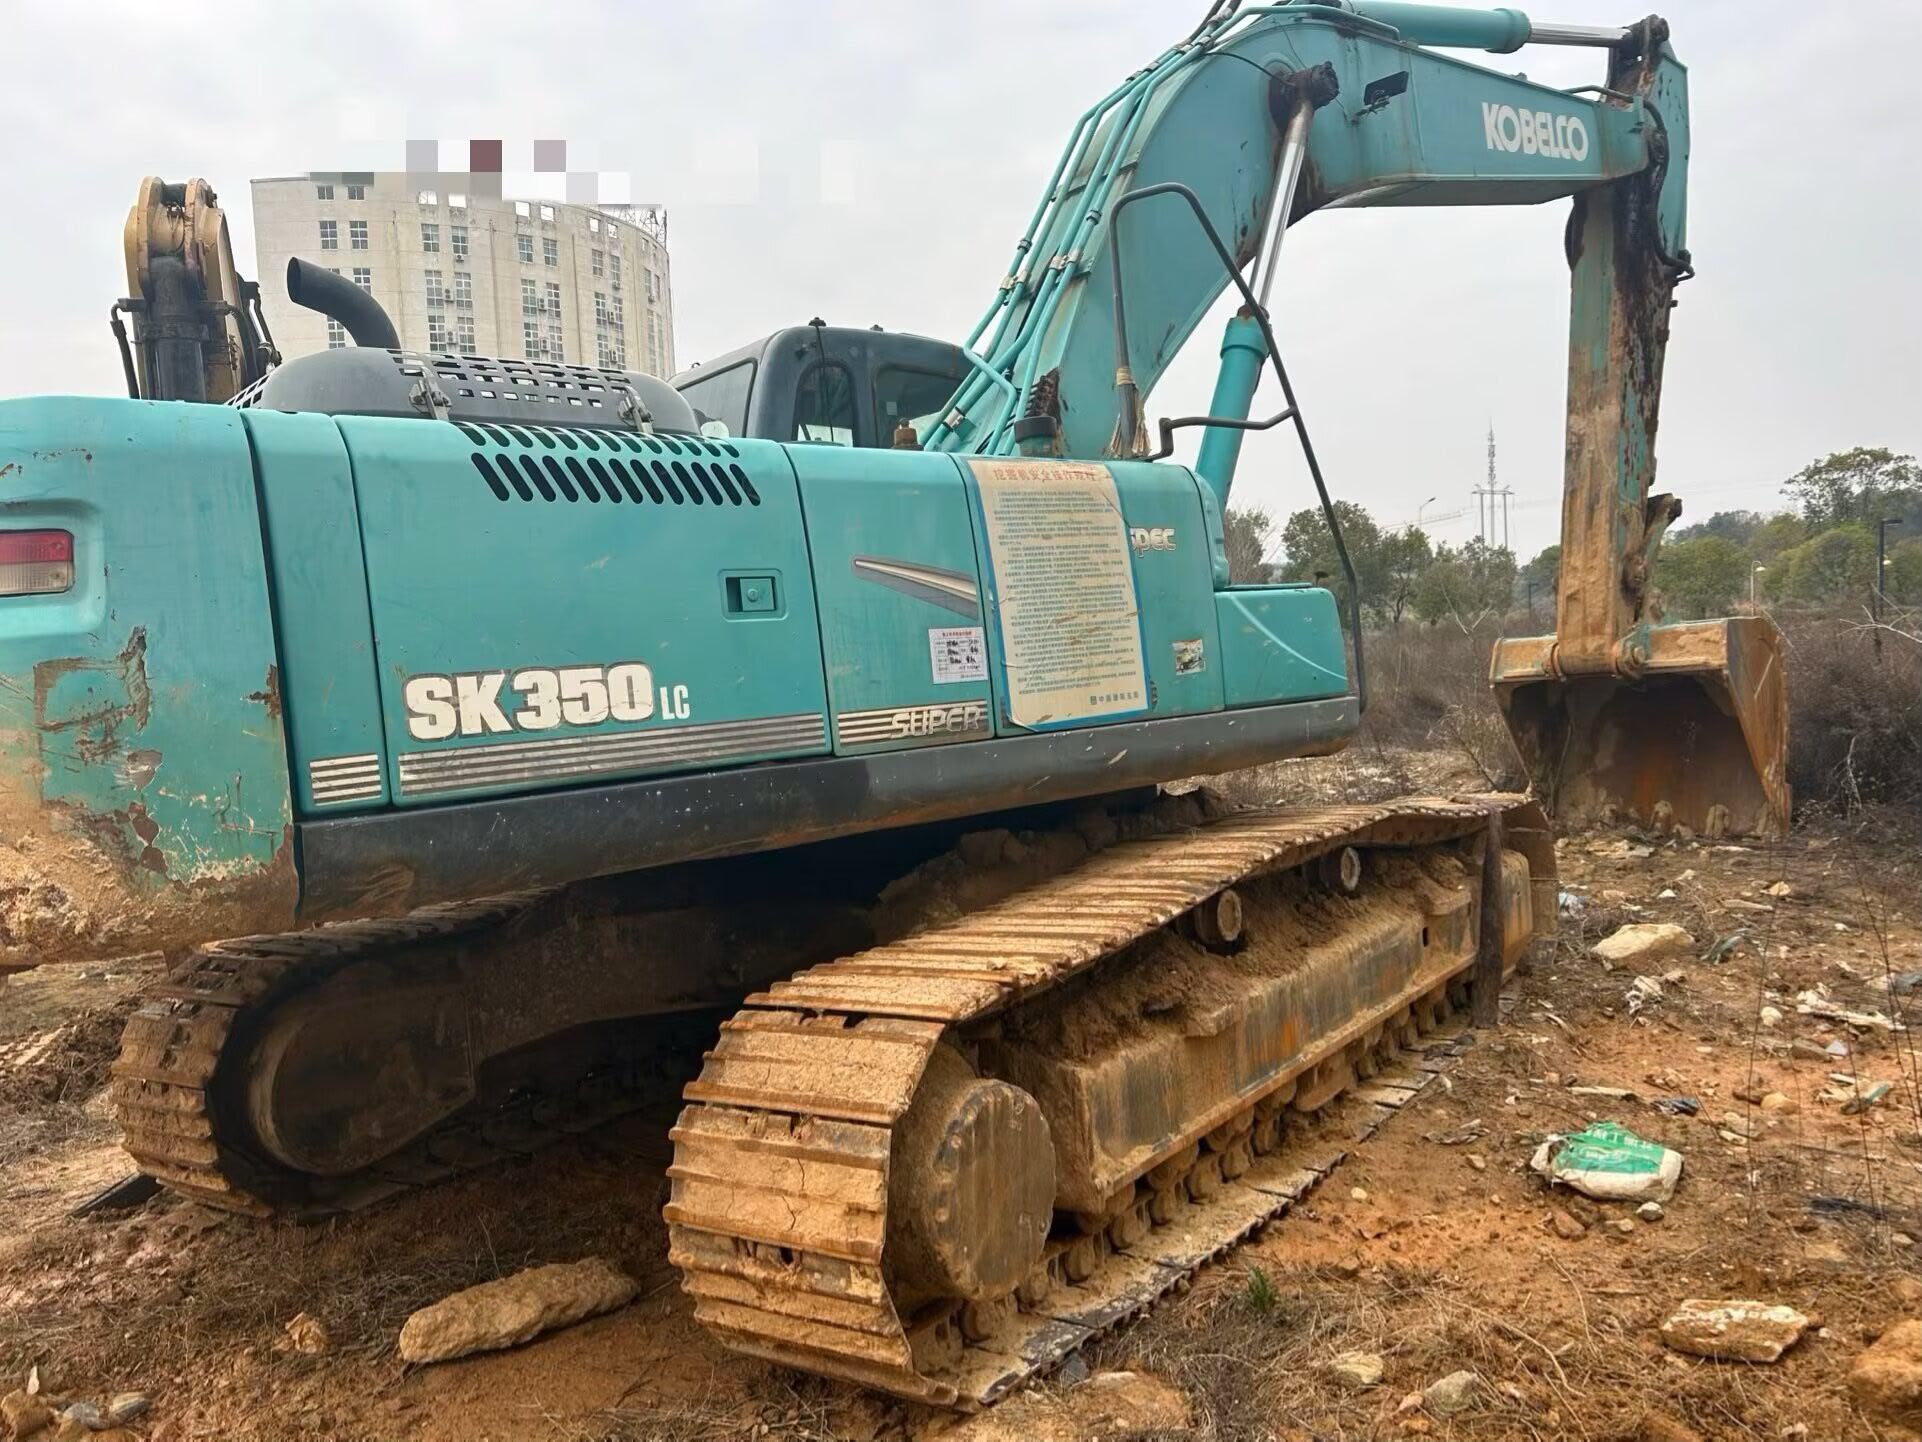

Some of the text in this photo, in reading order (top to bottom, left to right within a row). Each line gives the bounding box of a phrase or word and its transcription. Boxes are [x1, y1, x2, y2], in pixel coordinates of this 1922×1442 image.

[1481, 102, 1589, 161] KOBELCO
[405, 662, 691, 741] SK350 LC
[890, 706, 980, 738] SUPER
